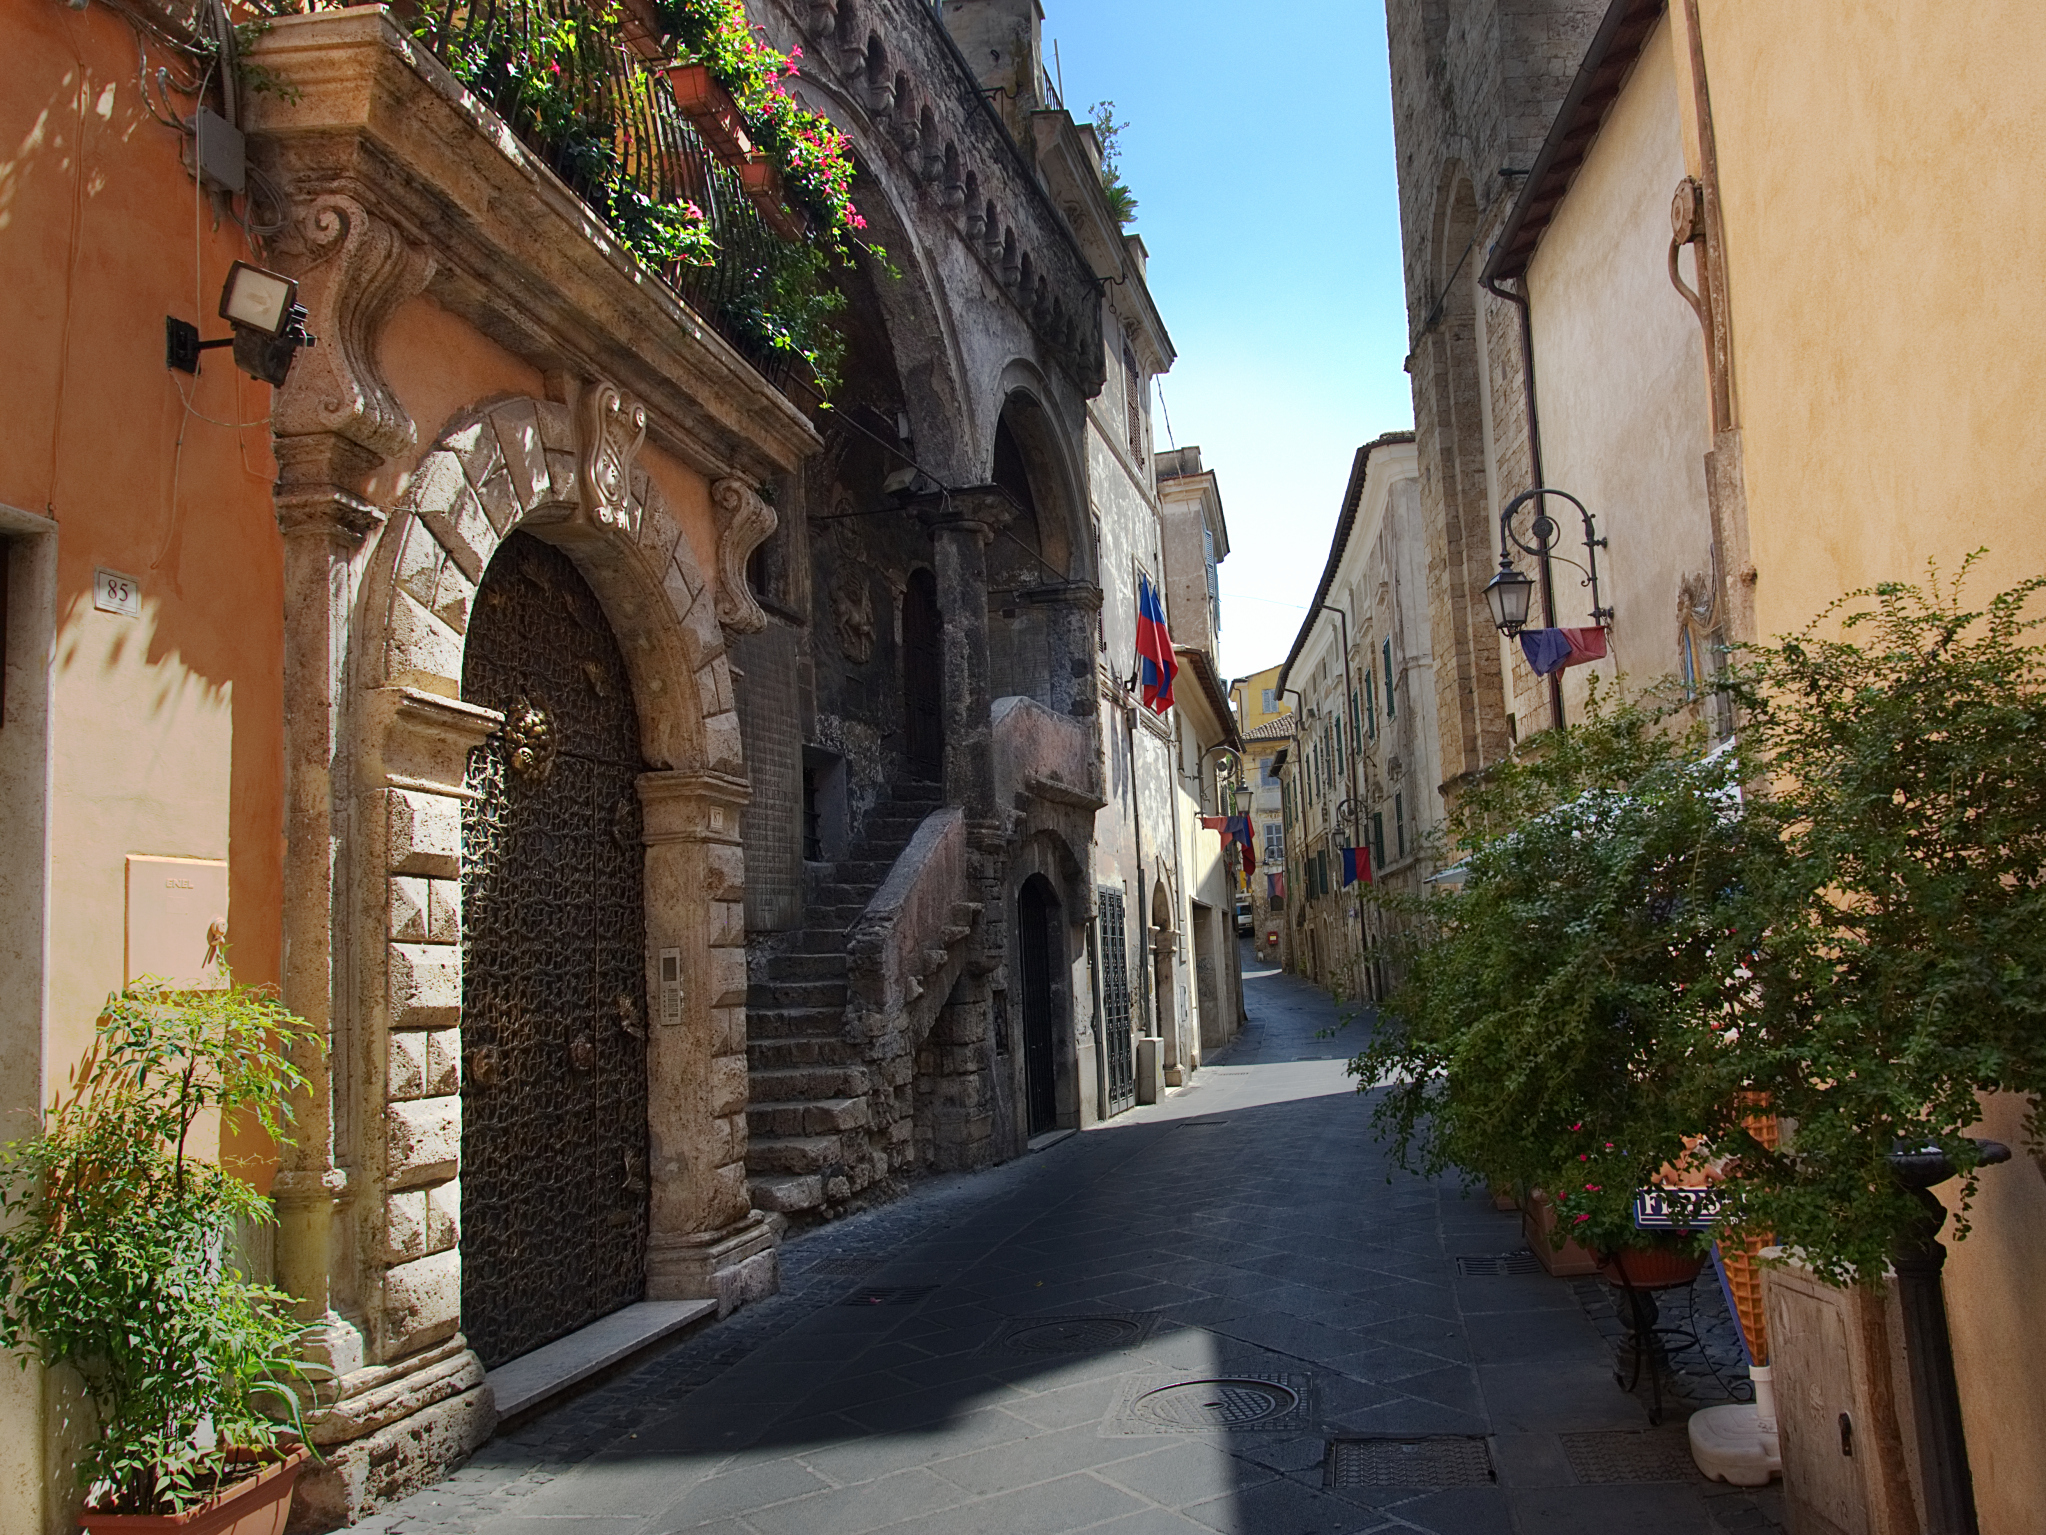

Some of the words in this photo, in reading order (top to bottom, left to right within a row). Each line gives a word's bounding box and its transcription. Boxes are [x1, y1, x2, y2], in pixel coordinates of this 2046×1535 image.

[108, 579, 129, 602] 85
[713, 811, 721, 824] 87
[165, 878, 194, 889] ENEL
